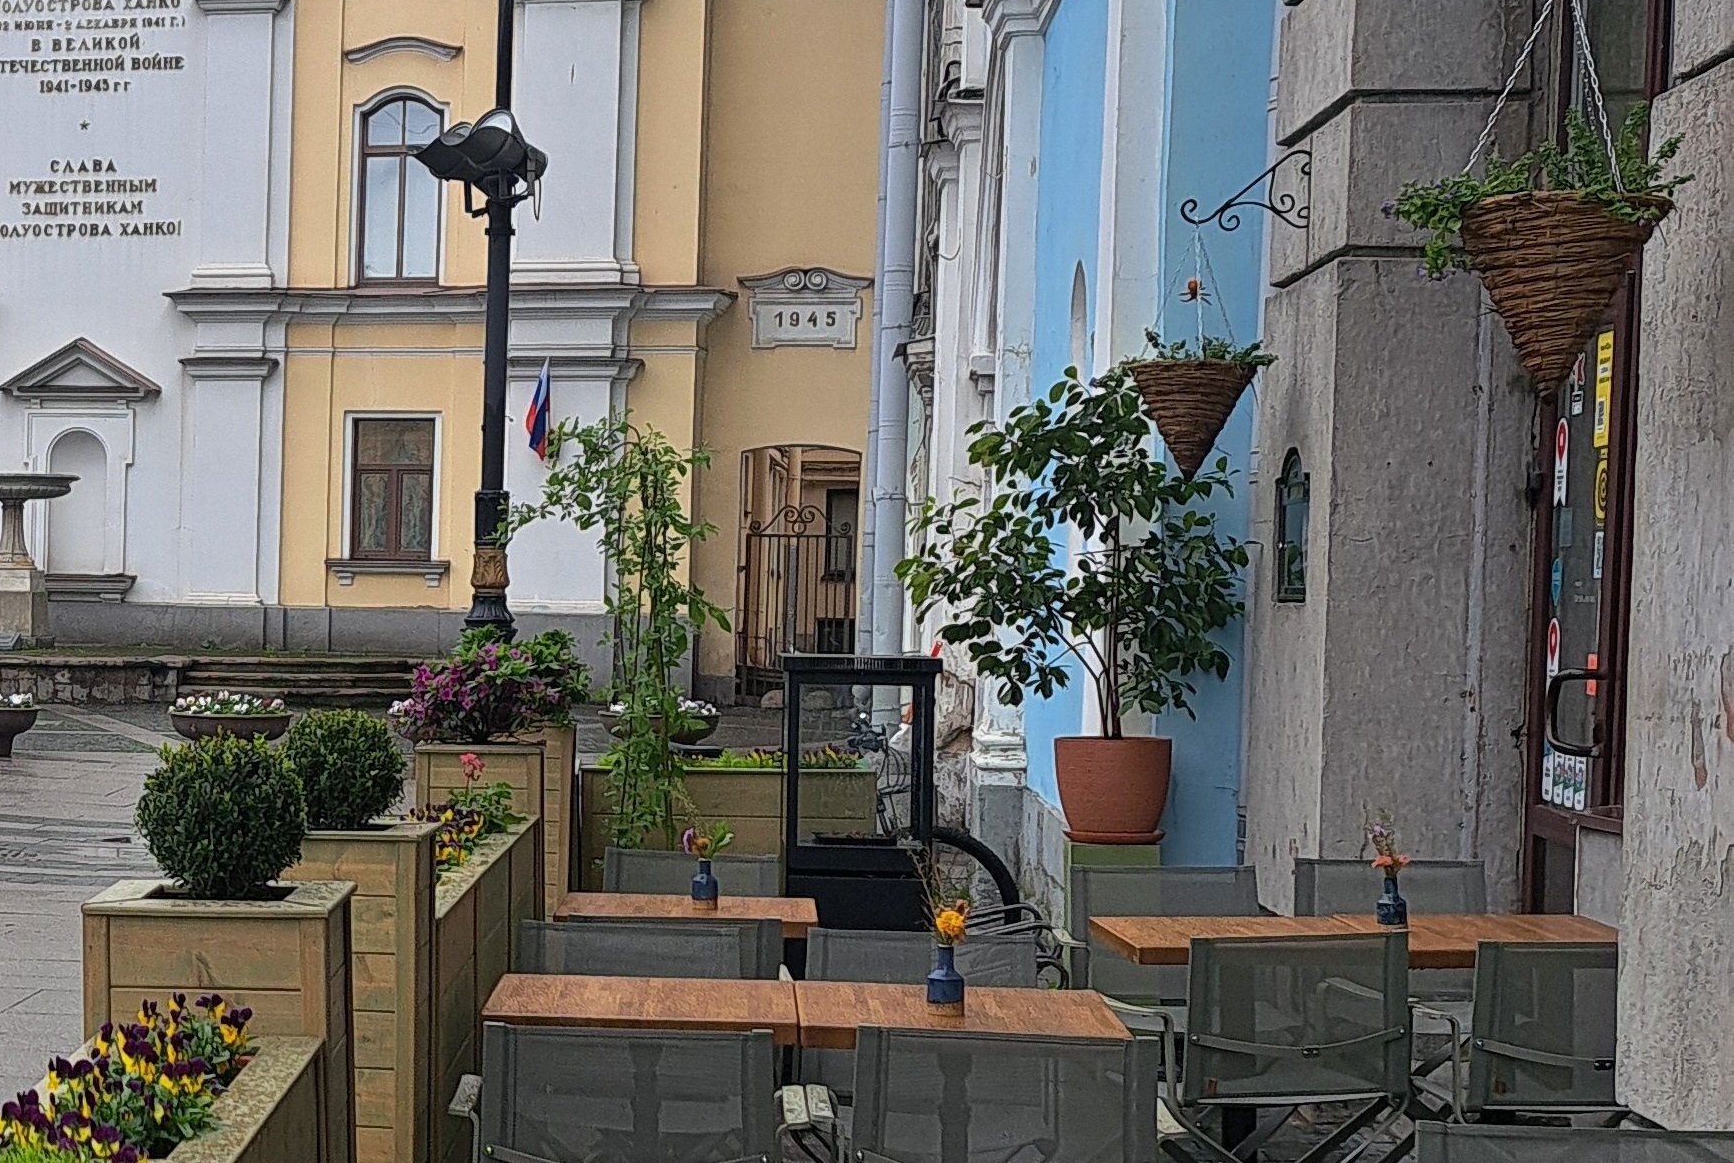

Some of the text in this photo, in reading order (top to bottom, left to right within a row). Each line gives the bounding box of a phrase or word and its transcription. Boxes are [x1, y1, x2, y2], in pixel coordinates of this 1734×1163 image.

[15, 19, 54, 31] ИЮНЯ
[141, 17, 166, 27] 1941
[31, 33, 141, 52] В ВЕЛИКОЙ
[131, 52, 185, 71] ВОЙНЕ
[39, 79, 110, 93] 1941-1945
[50, 159, 118, 173] СЛАВА
[9, 178, 158, 194] МУЖЕСТВЕННЫМ
[21, 200, 144, 216] ЗАЩИТНИКАМ
[119, 220, 182, 236] ХАНКО!
[774, 310, 837, 328] 1945
